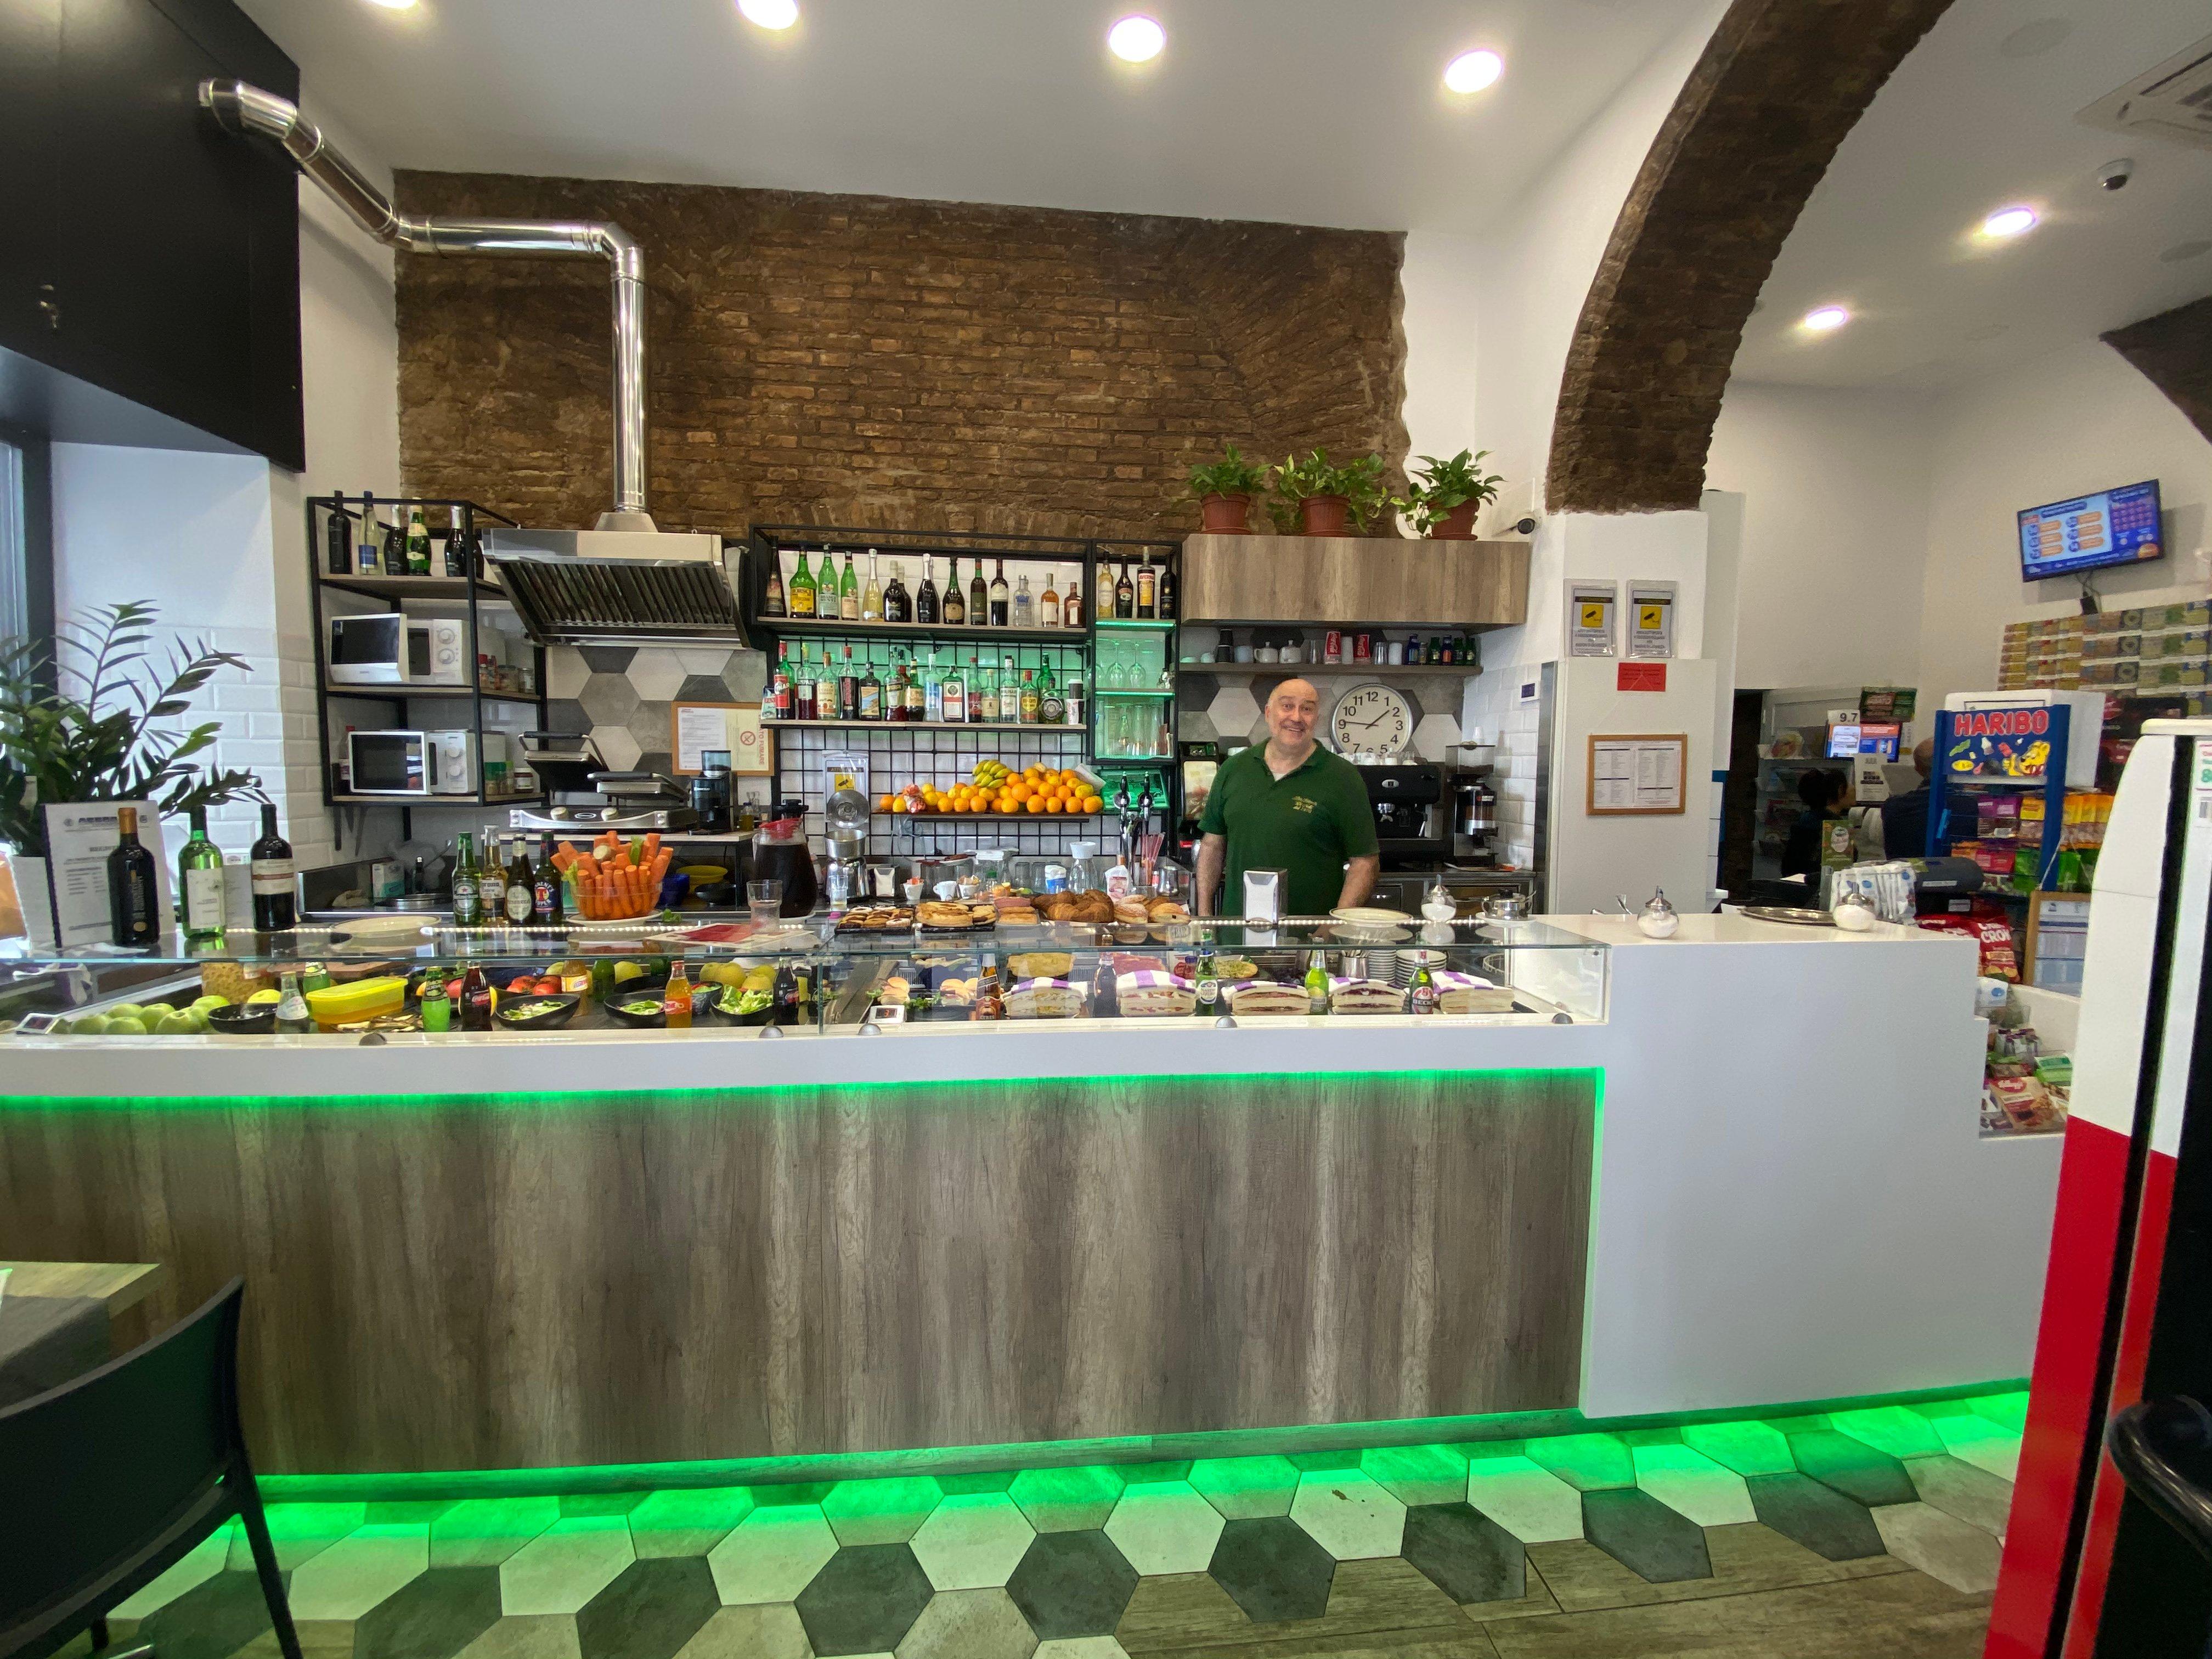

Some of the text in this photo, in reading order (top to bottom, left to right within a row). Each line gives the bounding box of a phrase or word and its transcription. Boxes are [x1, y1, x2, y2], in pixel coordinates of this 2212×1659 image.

[1353, 696, 1363, 706] 11
[1365, 691, 1379, 702] 12
[1384, 696, 1390, 707] 1
[1343, 706, 1356, 716] 10
[1392, 707, 1400, 717] 2
[1338, 719, 1346, 730] 9
[1395, 720, 1403, 731] 3
[1954, 709, 2049, 737] HARIBO
[1342, 732, 1350, 743] 8
[1390, 734, 1398, 744] 4
[1353, 743, 1361, 754] 7
[1380, 744, 1388, 754] 5
